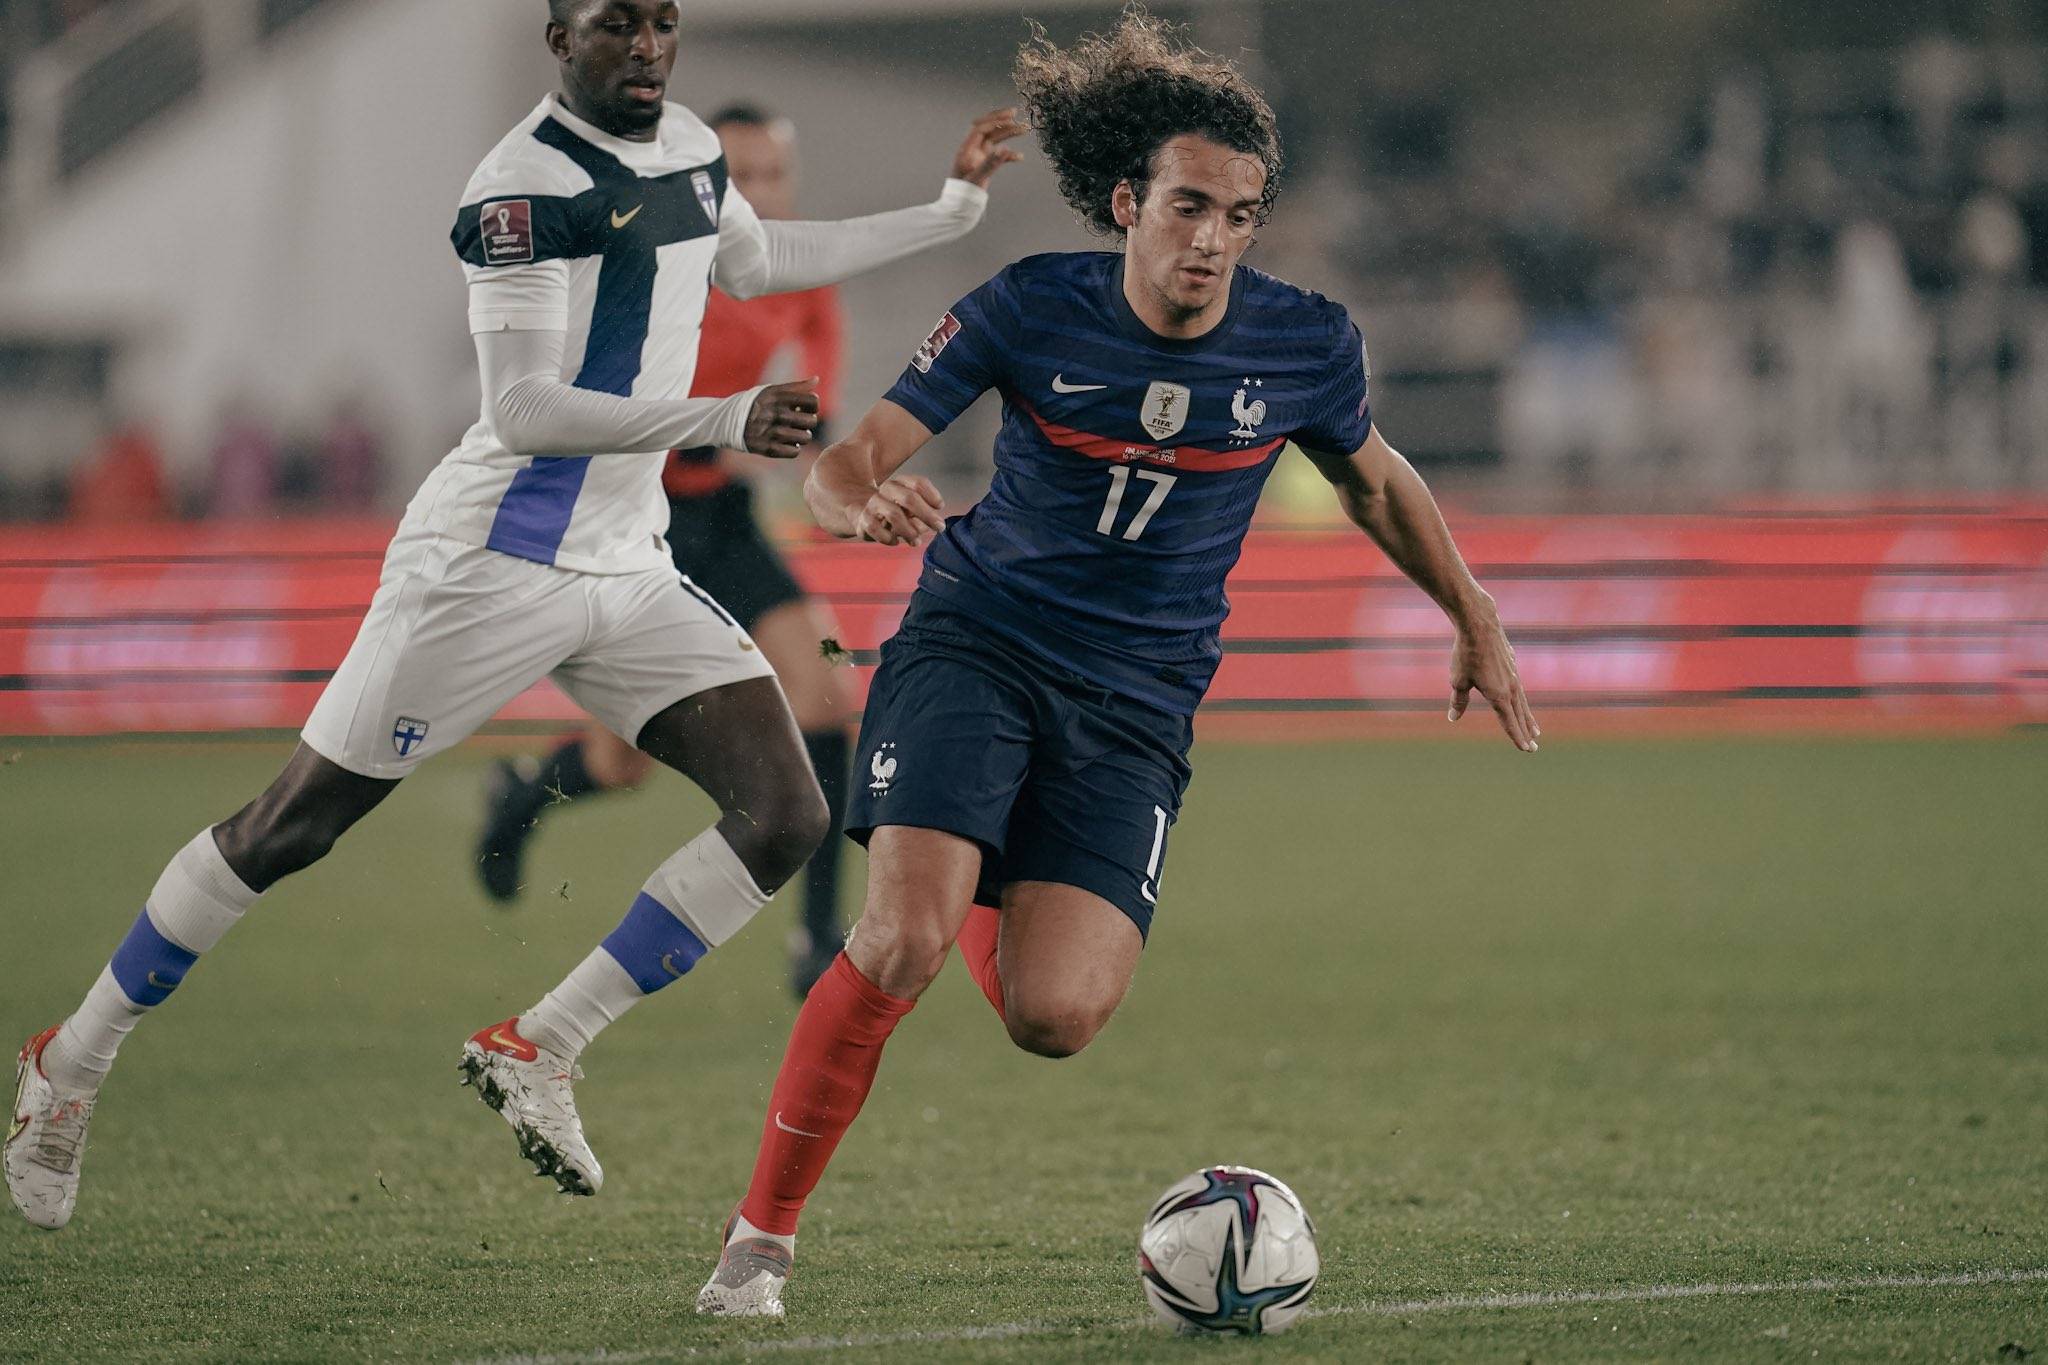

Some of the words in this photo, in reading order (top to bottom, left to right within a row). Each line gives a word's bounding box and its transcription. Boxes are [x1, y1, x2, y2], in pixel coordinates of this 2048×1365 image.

[1152, 417, 1171, 428] FIFA
[1096, 464, 1178, 542] 17
[1146, 804, 1168, 881] 1
